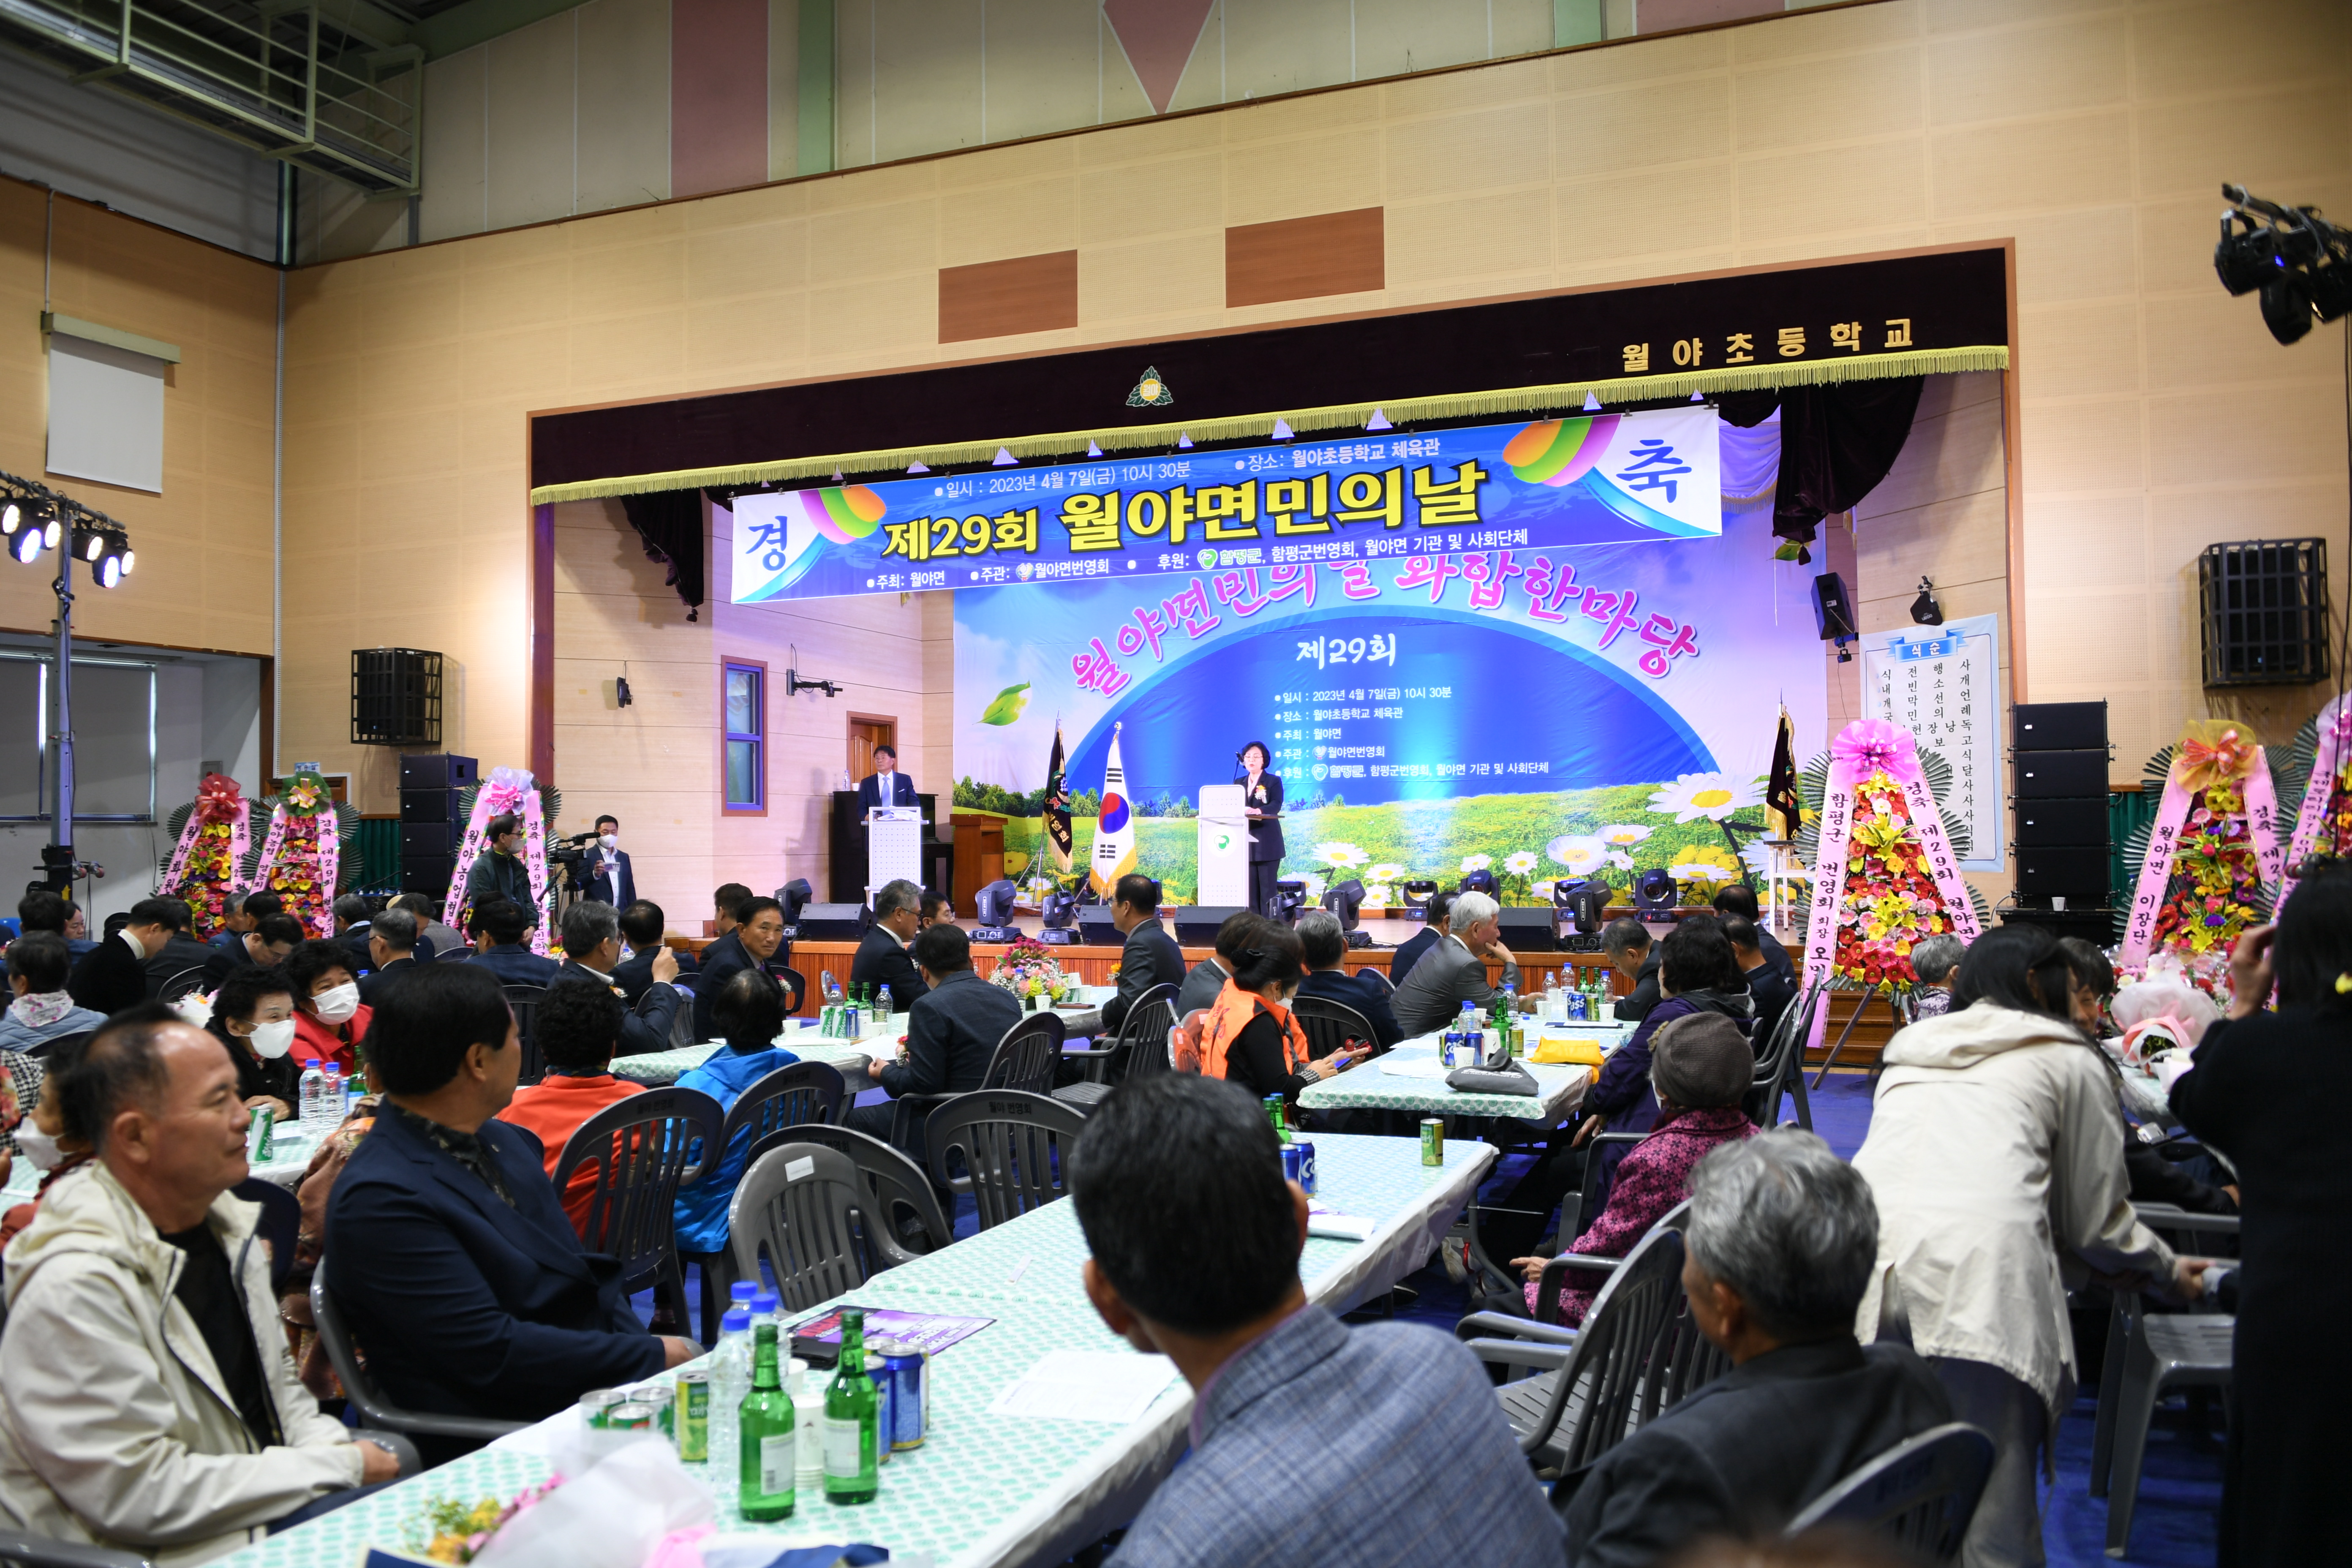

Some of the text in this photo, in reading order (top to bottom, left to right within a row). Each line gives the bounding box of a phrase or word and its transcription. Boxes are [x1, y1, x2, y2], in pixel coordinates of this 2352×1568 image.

[1622, 318, 1913, 373] 월야초등학교
[1291, 444, 1386, 468] 월야초등학교
[1391, 438, 1440, 458] 체육관
[946, 481, 972, 498] 일시
[989, 476, 1036, 493] 2023년
[1041, 471, 1064, 489] 4월
[1069, 467, 1115, 486] 7일(금)
[1122, 463, 1152, 482] 10시
[1158, 460, 1191, 479] 30분
[1617, 438, 1693, 504] 축
[747, 515, 788, 571] 경
[880, 506, 1038, 562] 제29회
[1272, 542, 1358, 562] 함평군번영회,
[1364, 538, 1407, 555] 월야면
[1413, 535, 1442, 552] 기관
[1448, 534, 1462, 549] 및
[1467, 528, 1528, 547] 사회단체
[910, 570, 945, 587] 월야면
[1034, 558, 1108, 579] 월야면번영회
[1296, 633, 1395, 670] 제29회
[1283, 692, 1301, 703] 일시
[1313, 689, 1345, 701] 2023년
[1349, 688, 1364, 700] 4월
[1368, 687, 1400, 700] 7일(금)
[1404, 686, 1426, 699] 10시
[1429, 686, 1452, 698] 30분
[1283, 710, 1301, 721] 장소
[1313, 708, 1370, 721] 월야초등학교
[1374, 707, 1403, 719] 체육관
[1283, 730, 1302, 741] 주최
[1313, 727, 1341, 740] 월야면
[1283, 749, 1302, 760] 주관
[1328, 746, 1385, 759] 월야면번영회
[1283, 767, 1302, 779] 후원
[1370, 763, 1432, 777] 함평군번영회,
[1436, 762, 1466, 776] 월야면
[1470, 762, 1490, 775] 기관
[1494, 762, 1504, 774] 및
[1507, 760, 1549, 774] 사회단체
[235, 822, 247, 841] 경축
[319, 819, 335, 836] 경축
[1826, 794, 1849, 842] 함평군
[2253, 806, 2272, 831] 경축
[321, 847, 333, 887] 제29회
[1905, 782, 1976, 944] 경축 제29회 월야면
[528, 821, 545, 956] 경축 제29회 월야면민의
[1816, 861, 1839, 910] 번영회
[2133, 826, 2175, 944] 월야면 이장단
[1815, 916, 1829, 938] 회장
[989, 1101, 1032, 1115] 월야 번영회
